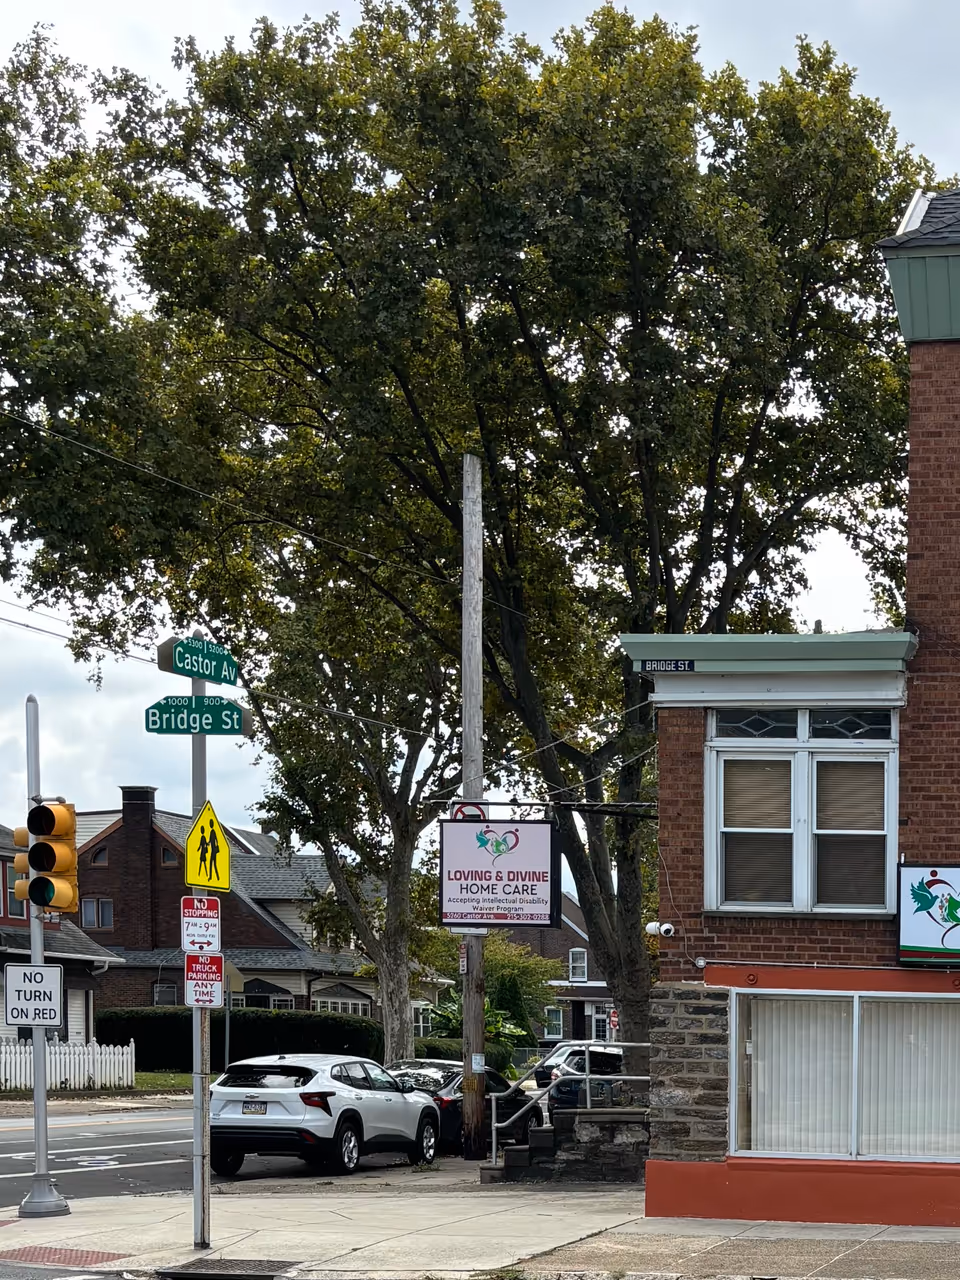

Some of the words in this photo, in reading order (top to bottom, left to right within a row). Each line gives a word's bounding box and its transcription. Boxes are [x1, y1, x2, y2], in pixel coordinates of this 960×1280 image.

[188, 639, 202, 649] 5300
[209, 645, 223, 655] 5200
[175, 646, 216, 676] Castor
[221, 661, 236, 681] Av
[646, 661, 676, 670] BRIDGE
[678, 661, 690, 670] ST.
[168, 697, 188, 706] 1000
[203, 697, 220, 706] 900
[148, 708, 213, 733] Bridge
[221, 710, 239, 729] St
[447, 870, 492, 881] LOVING
[495, 870, 504, 882] &
[507, 870, 549, 882] DIVINE
[459, 883, 498, 895] HOME
[502, 884, 538, 895] CARE
[194, 898, 208, 910] NO
[518, 897, 549, 905] Disability
[184, 909, 218, 917] STOPPING
[496, 905, 524, 913] Program
[199, 956, 210, 964] NO
[192, 964, 217, 972] TRUCK
[23, 972, 43, 983] NO
[188, 972, 221, 981] PARKING
[193, 981, 216, 990] ANY
[15, 990, 52, 1001] TURN
[193, 989, 216, 998] TIME
[11, 1007, 28, 1019] ON
[33, 1007, 57, 1020] RED
